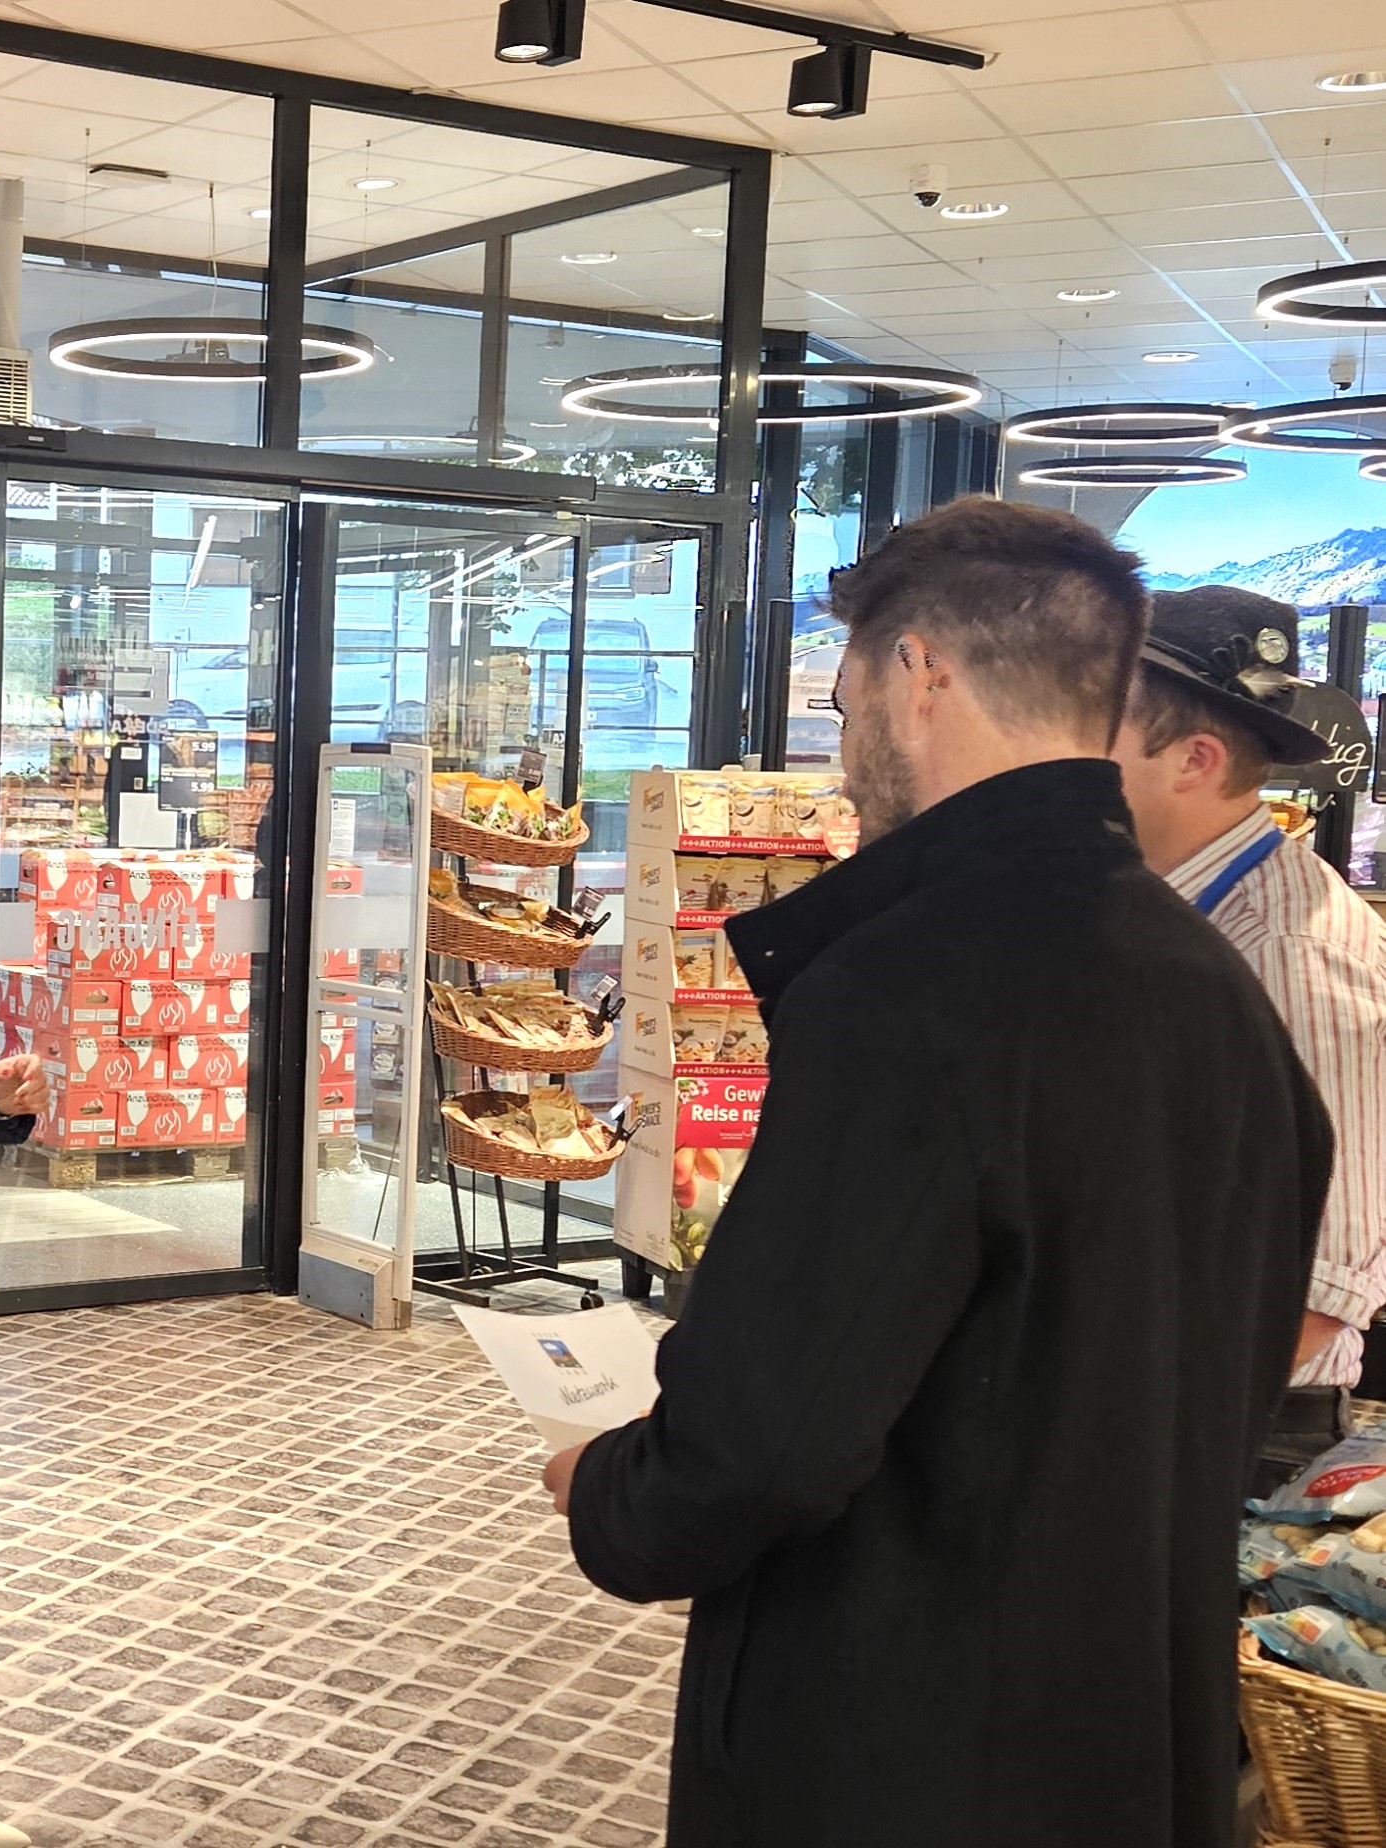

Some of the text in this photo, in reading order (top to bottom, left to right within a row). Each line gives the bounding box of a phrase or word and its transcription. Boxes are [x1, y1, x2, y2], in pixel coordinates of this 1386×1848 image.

[192, 742, 216, 752] 5.99
[191, 782, 215, 792] 5.99
[724, 1085, 766, 1102] Gewi
[691, 1104, 761, 1122] Reise na
[717, 1184, 731, 1207] K
